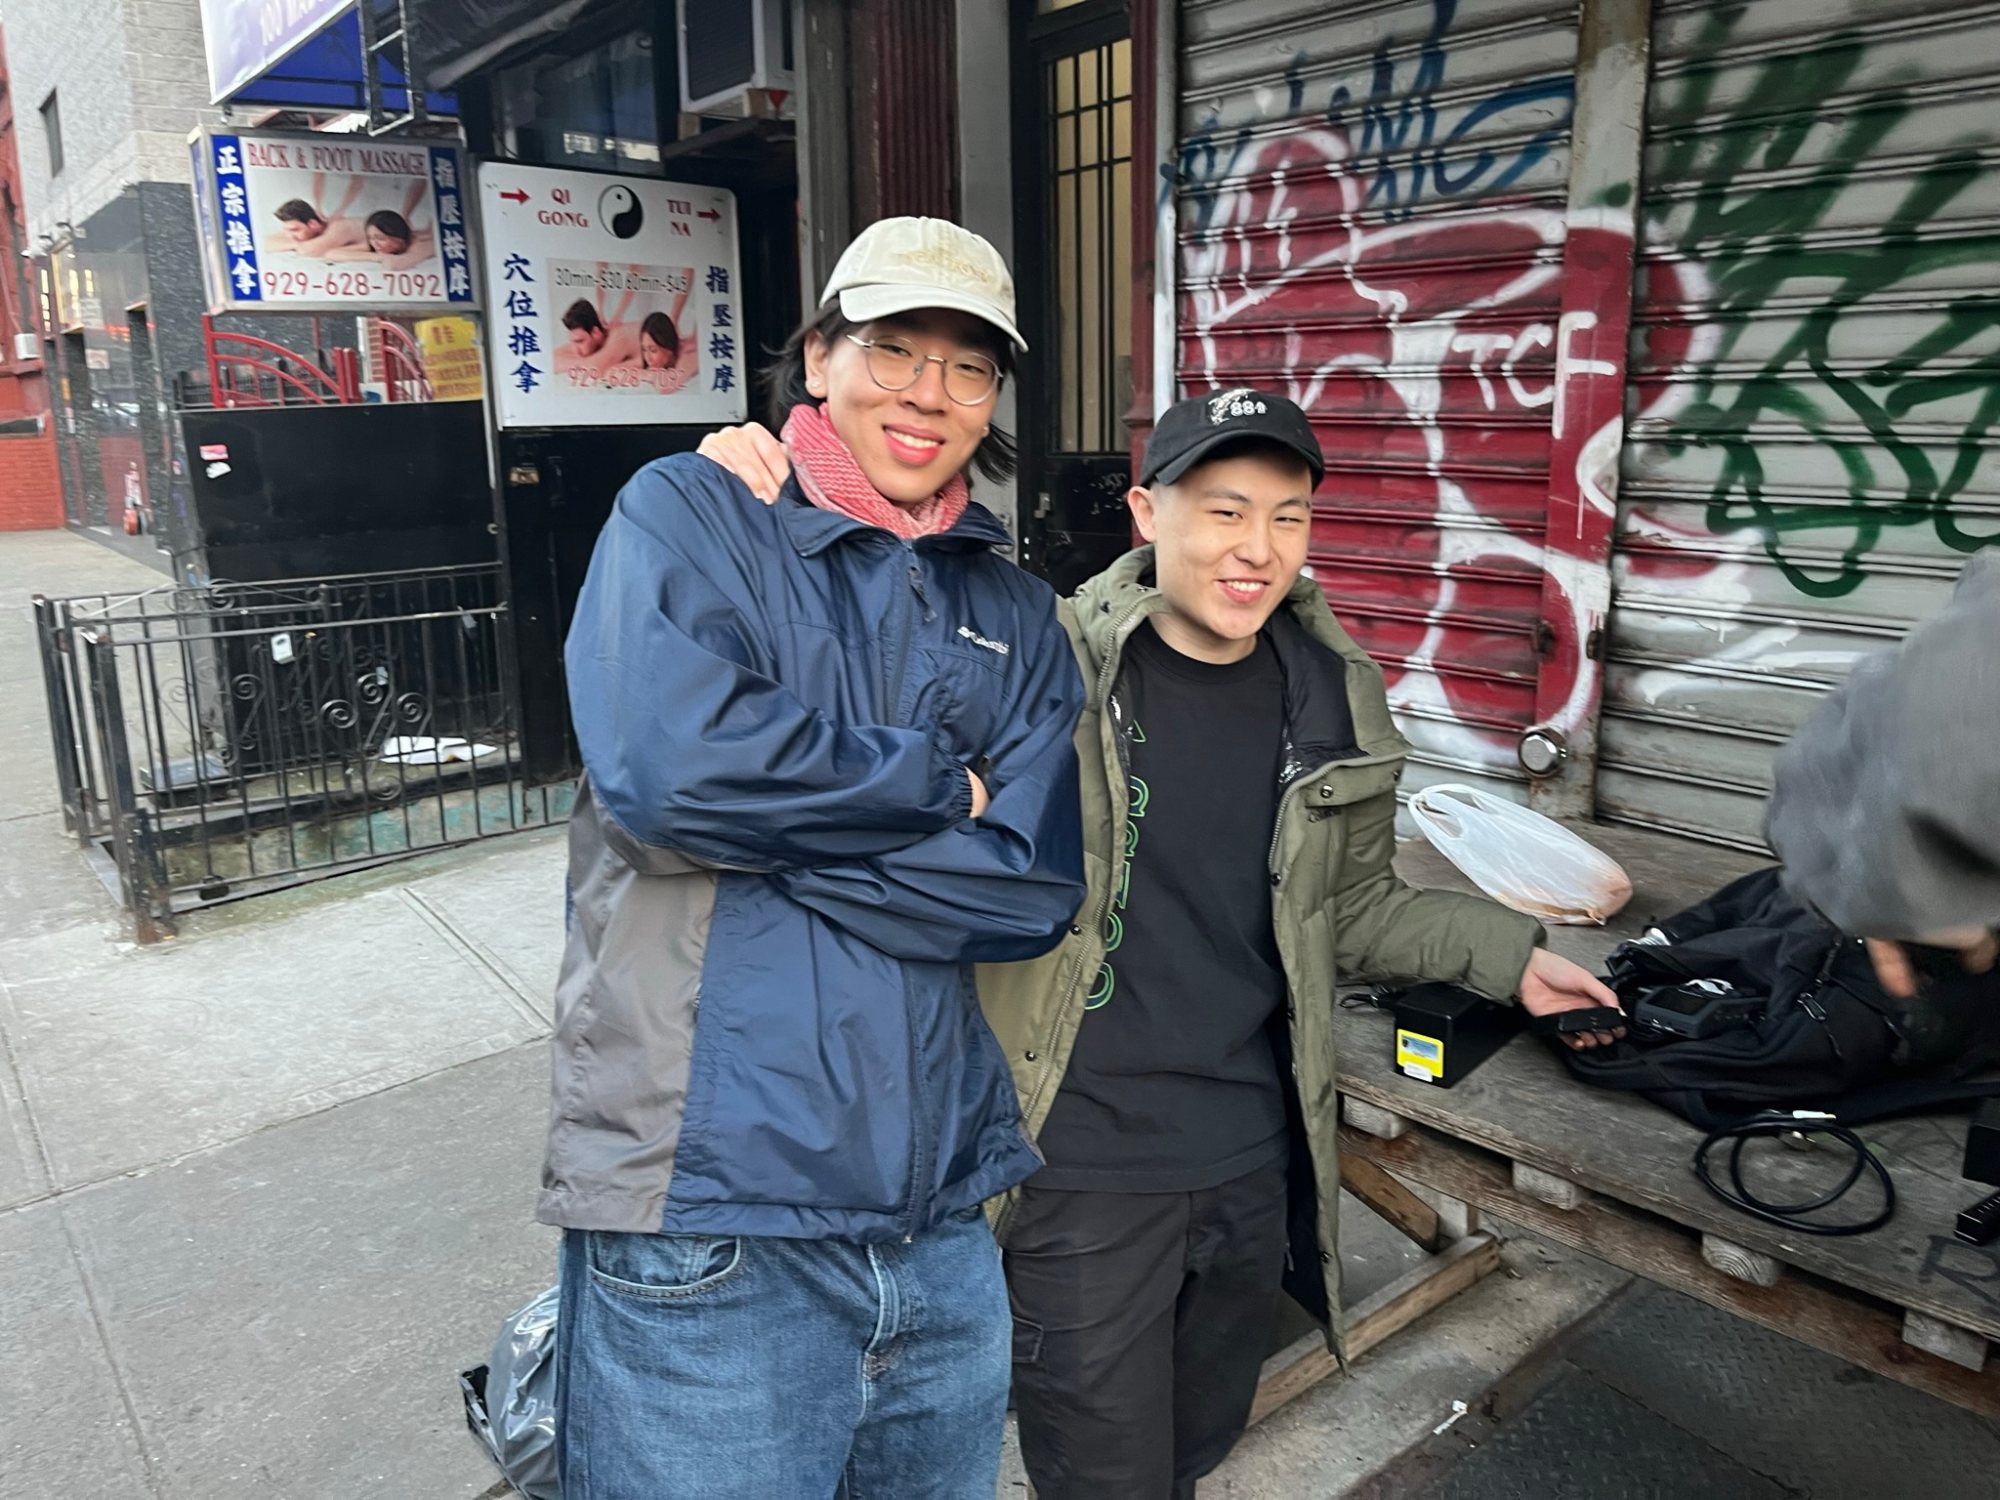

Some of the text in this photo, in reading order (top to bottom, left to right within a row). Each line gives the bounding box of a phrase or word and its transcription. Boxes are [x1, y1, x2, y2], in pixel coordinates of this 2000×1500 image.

[247, 143, 428, 176] BACK & FOOT MASSAGE
[551, 188, 571, 205] QI
[667, 199, 691, 216] TUI
[216, 145, 257, 295] 正宗推拿
[537, 210, 589, 228] GONG
[670, 221, 691, 237] NA
[264, 271, 442, 297] 929-628-7092
[503, 252, 543, 394] 穴位推拿
